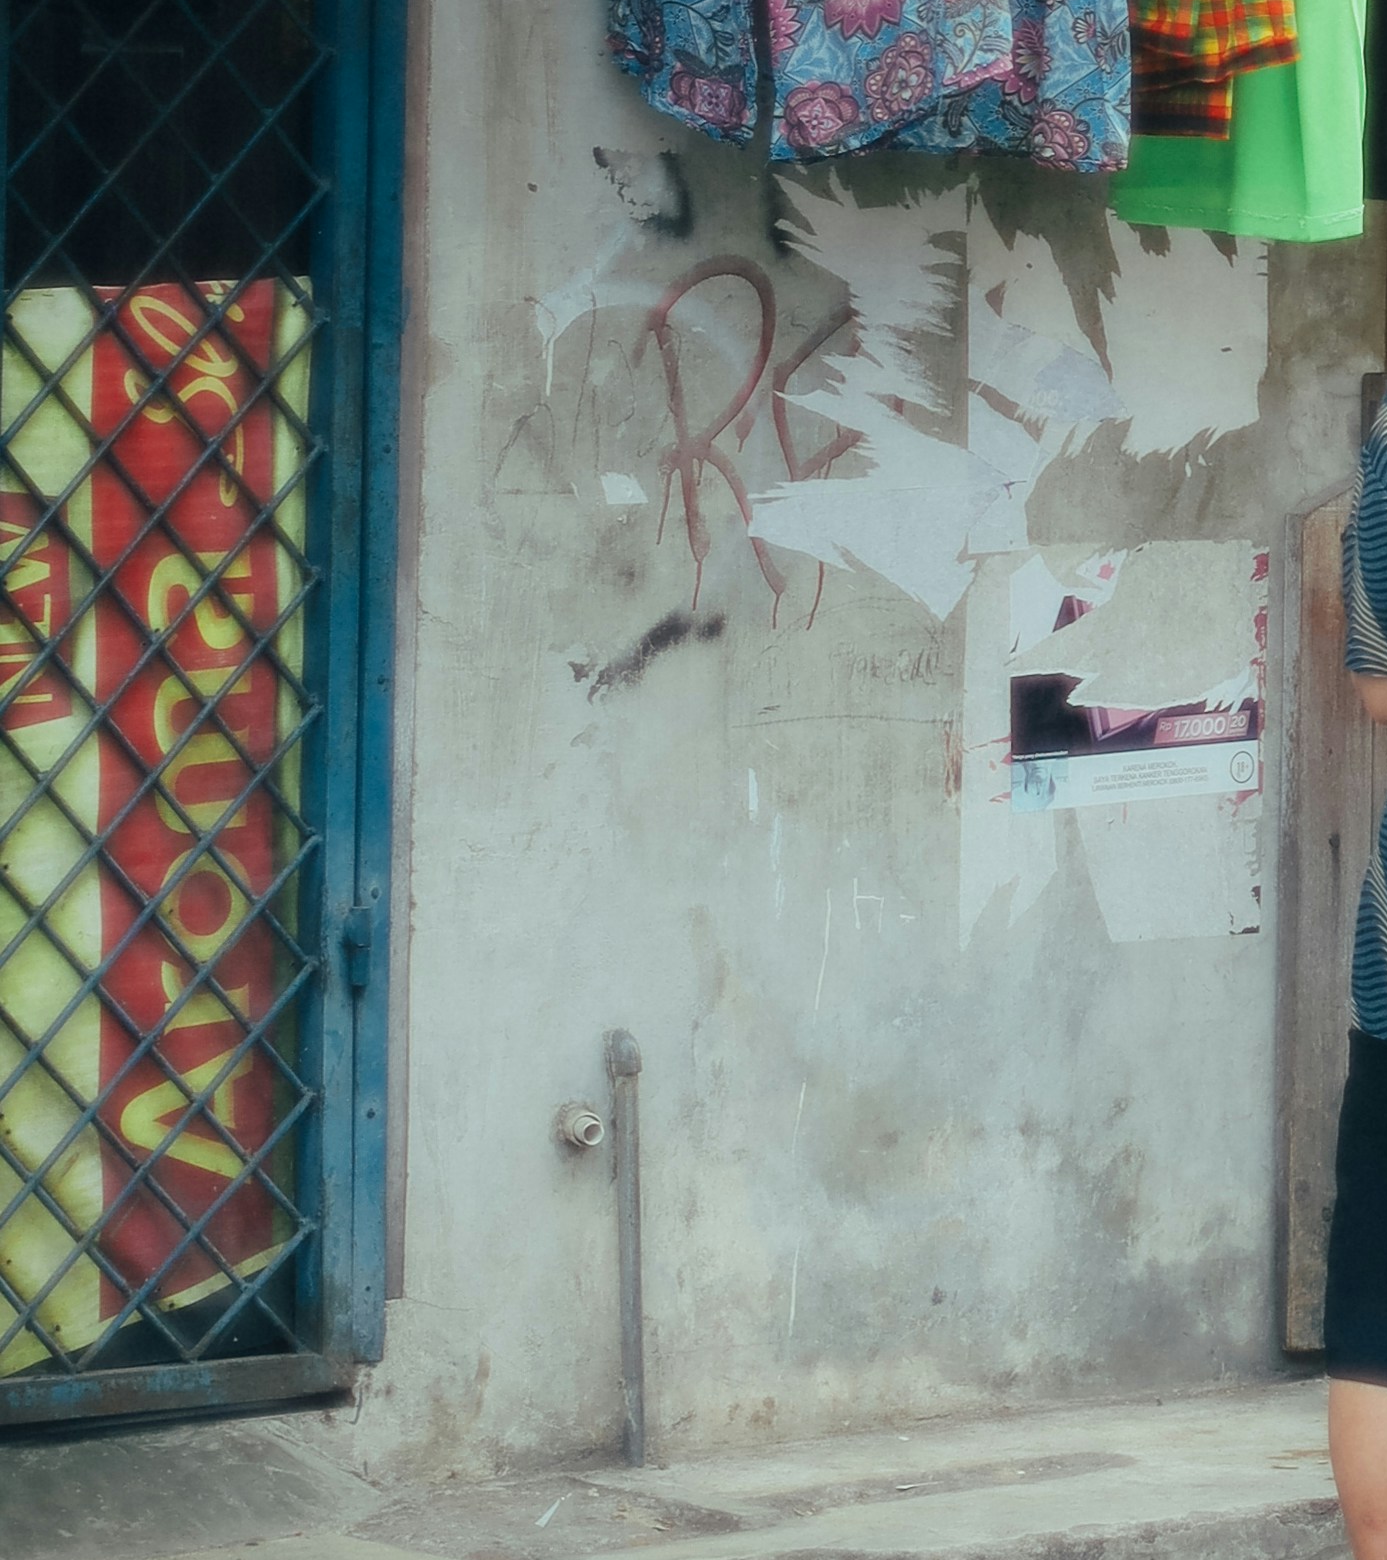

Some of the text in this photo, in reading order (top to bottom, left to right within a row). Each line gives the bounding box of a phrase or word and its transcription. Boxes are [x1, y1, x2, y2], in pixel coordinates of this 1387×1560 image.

[0, 521, 54, 708] NEW
[1111, 772, 1138, 783] TERKENA
[1139, 770, 1164, 780] KANKER
[1160, 715, 1246, 738] Rp 17.000 20
[121, 549, 255, 1187] Aroma
